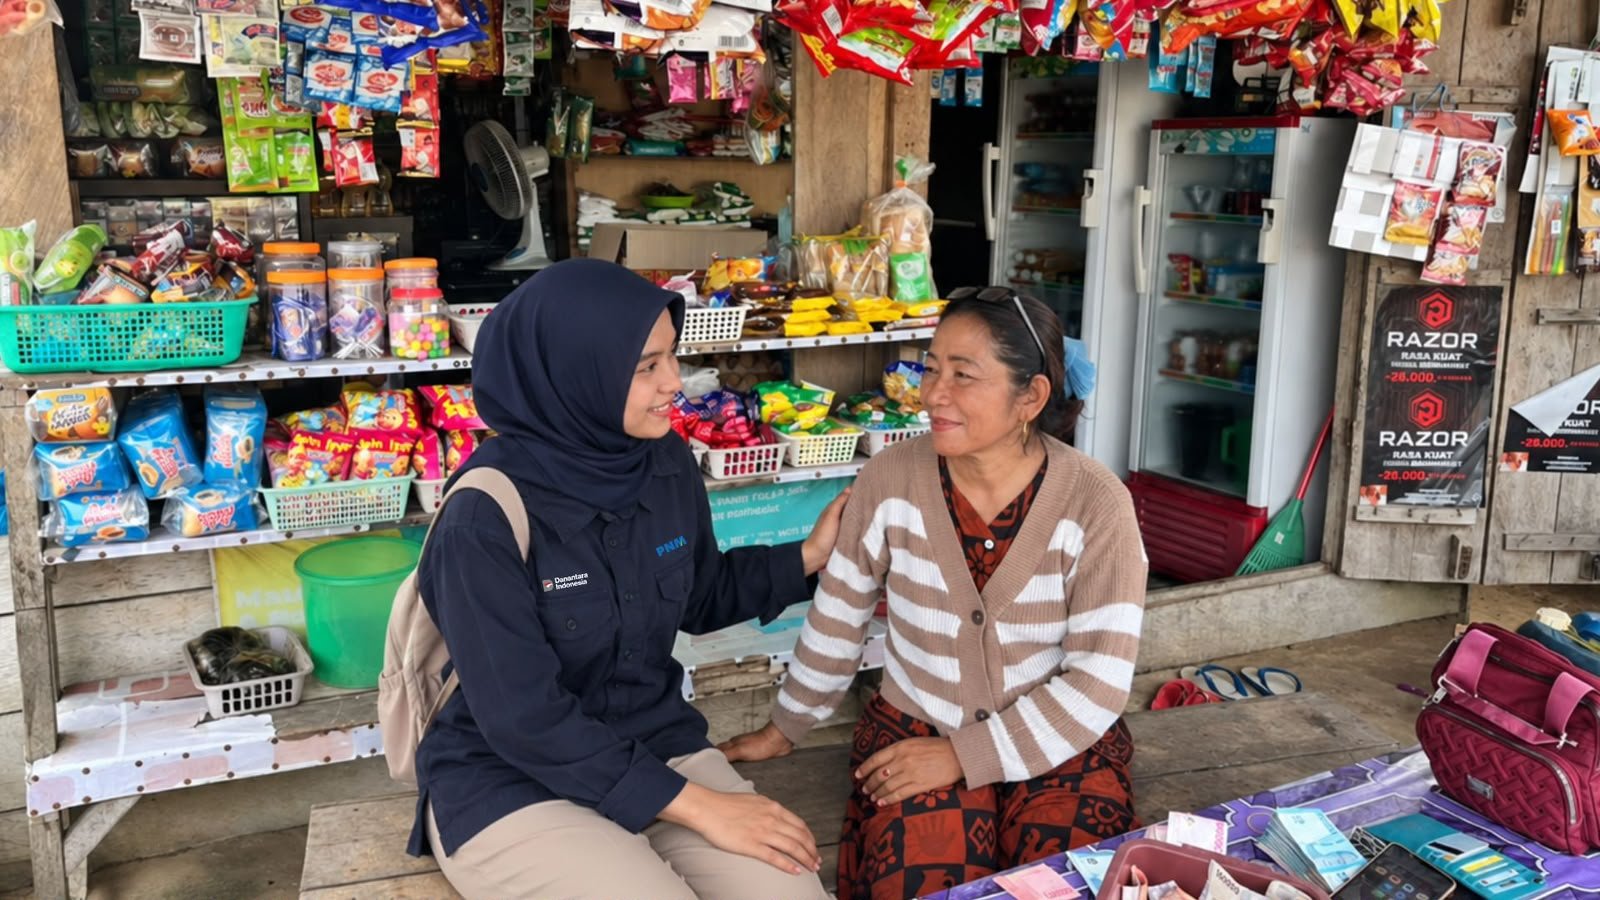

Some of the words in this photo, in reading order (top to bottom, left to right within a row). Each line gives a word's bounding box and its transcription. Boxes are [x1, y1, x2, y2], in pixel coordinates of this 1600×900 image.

[1387, 331, 1478, 349] RAZOR
[1401, 352, 1430, 360] RASA
[1433, 353, 1463, 361] KUAT
[1379, 431, 1468, 447] RAZOR
[655, 535, 687, 557] PNM
[554, 572, 589, 584] Danantara
[555, 579, 588, 590] Indonesia
